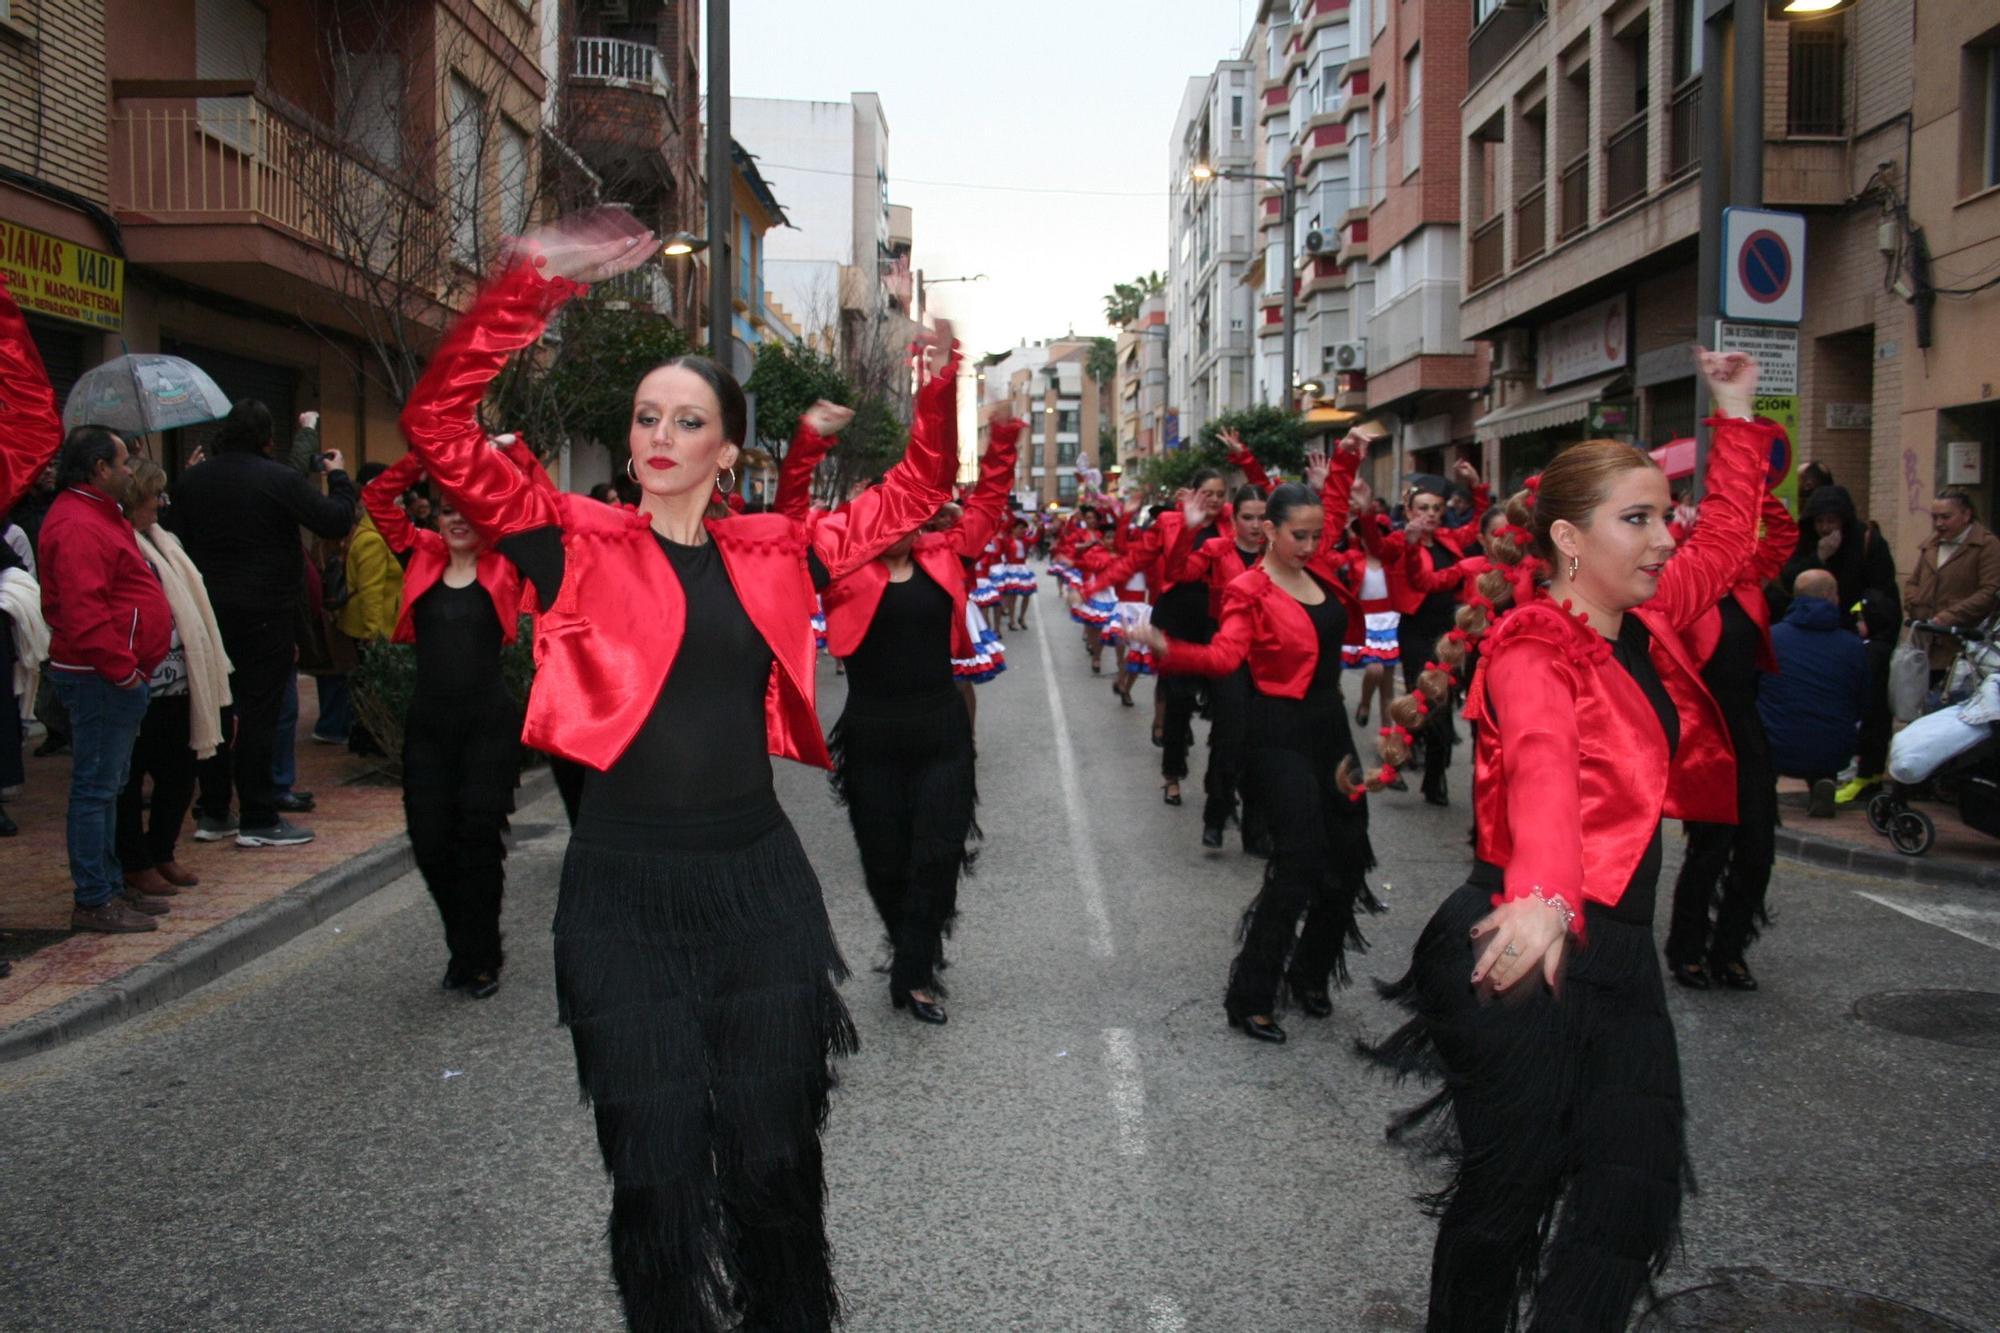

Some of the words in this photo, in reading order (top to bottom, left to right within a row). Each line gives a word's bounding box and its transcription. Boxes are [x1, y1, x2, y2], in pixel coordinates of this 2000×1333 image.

[77, 248, 116, 292] VADI
[32, 275, 40, 292] Y
[44, 279, 121, 313] MARQUETERIA
[1752, 398, 1791, 411] CIÓN
